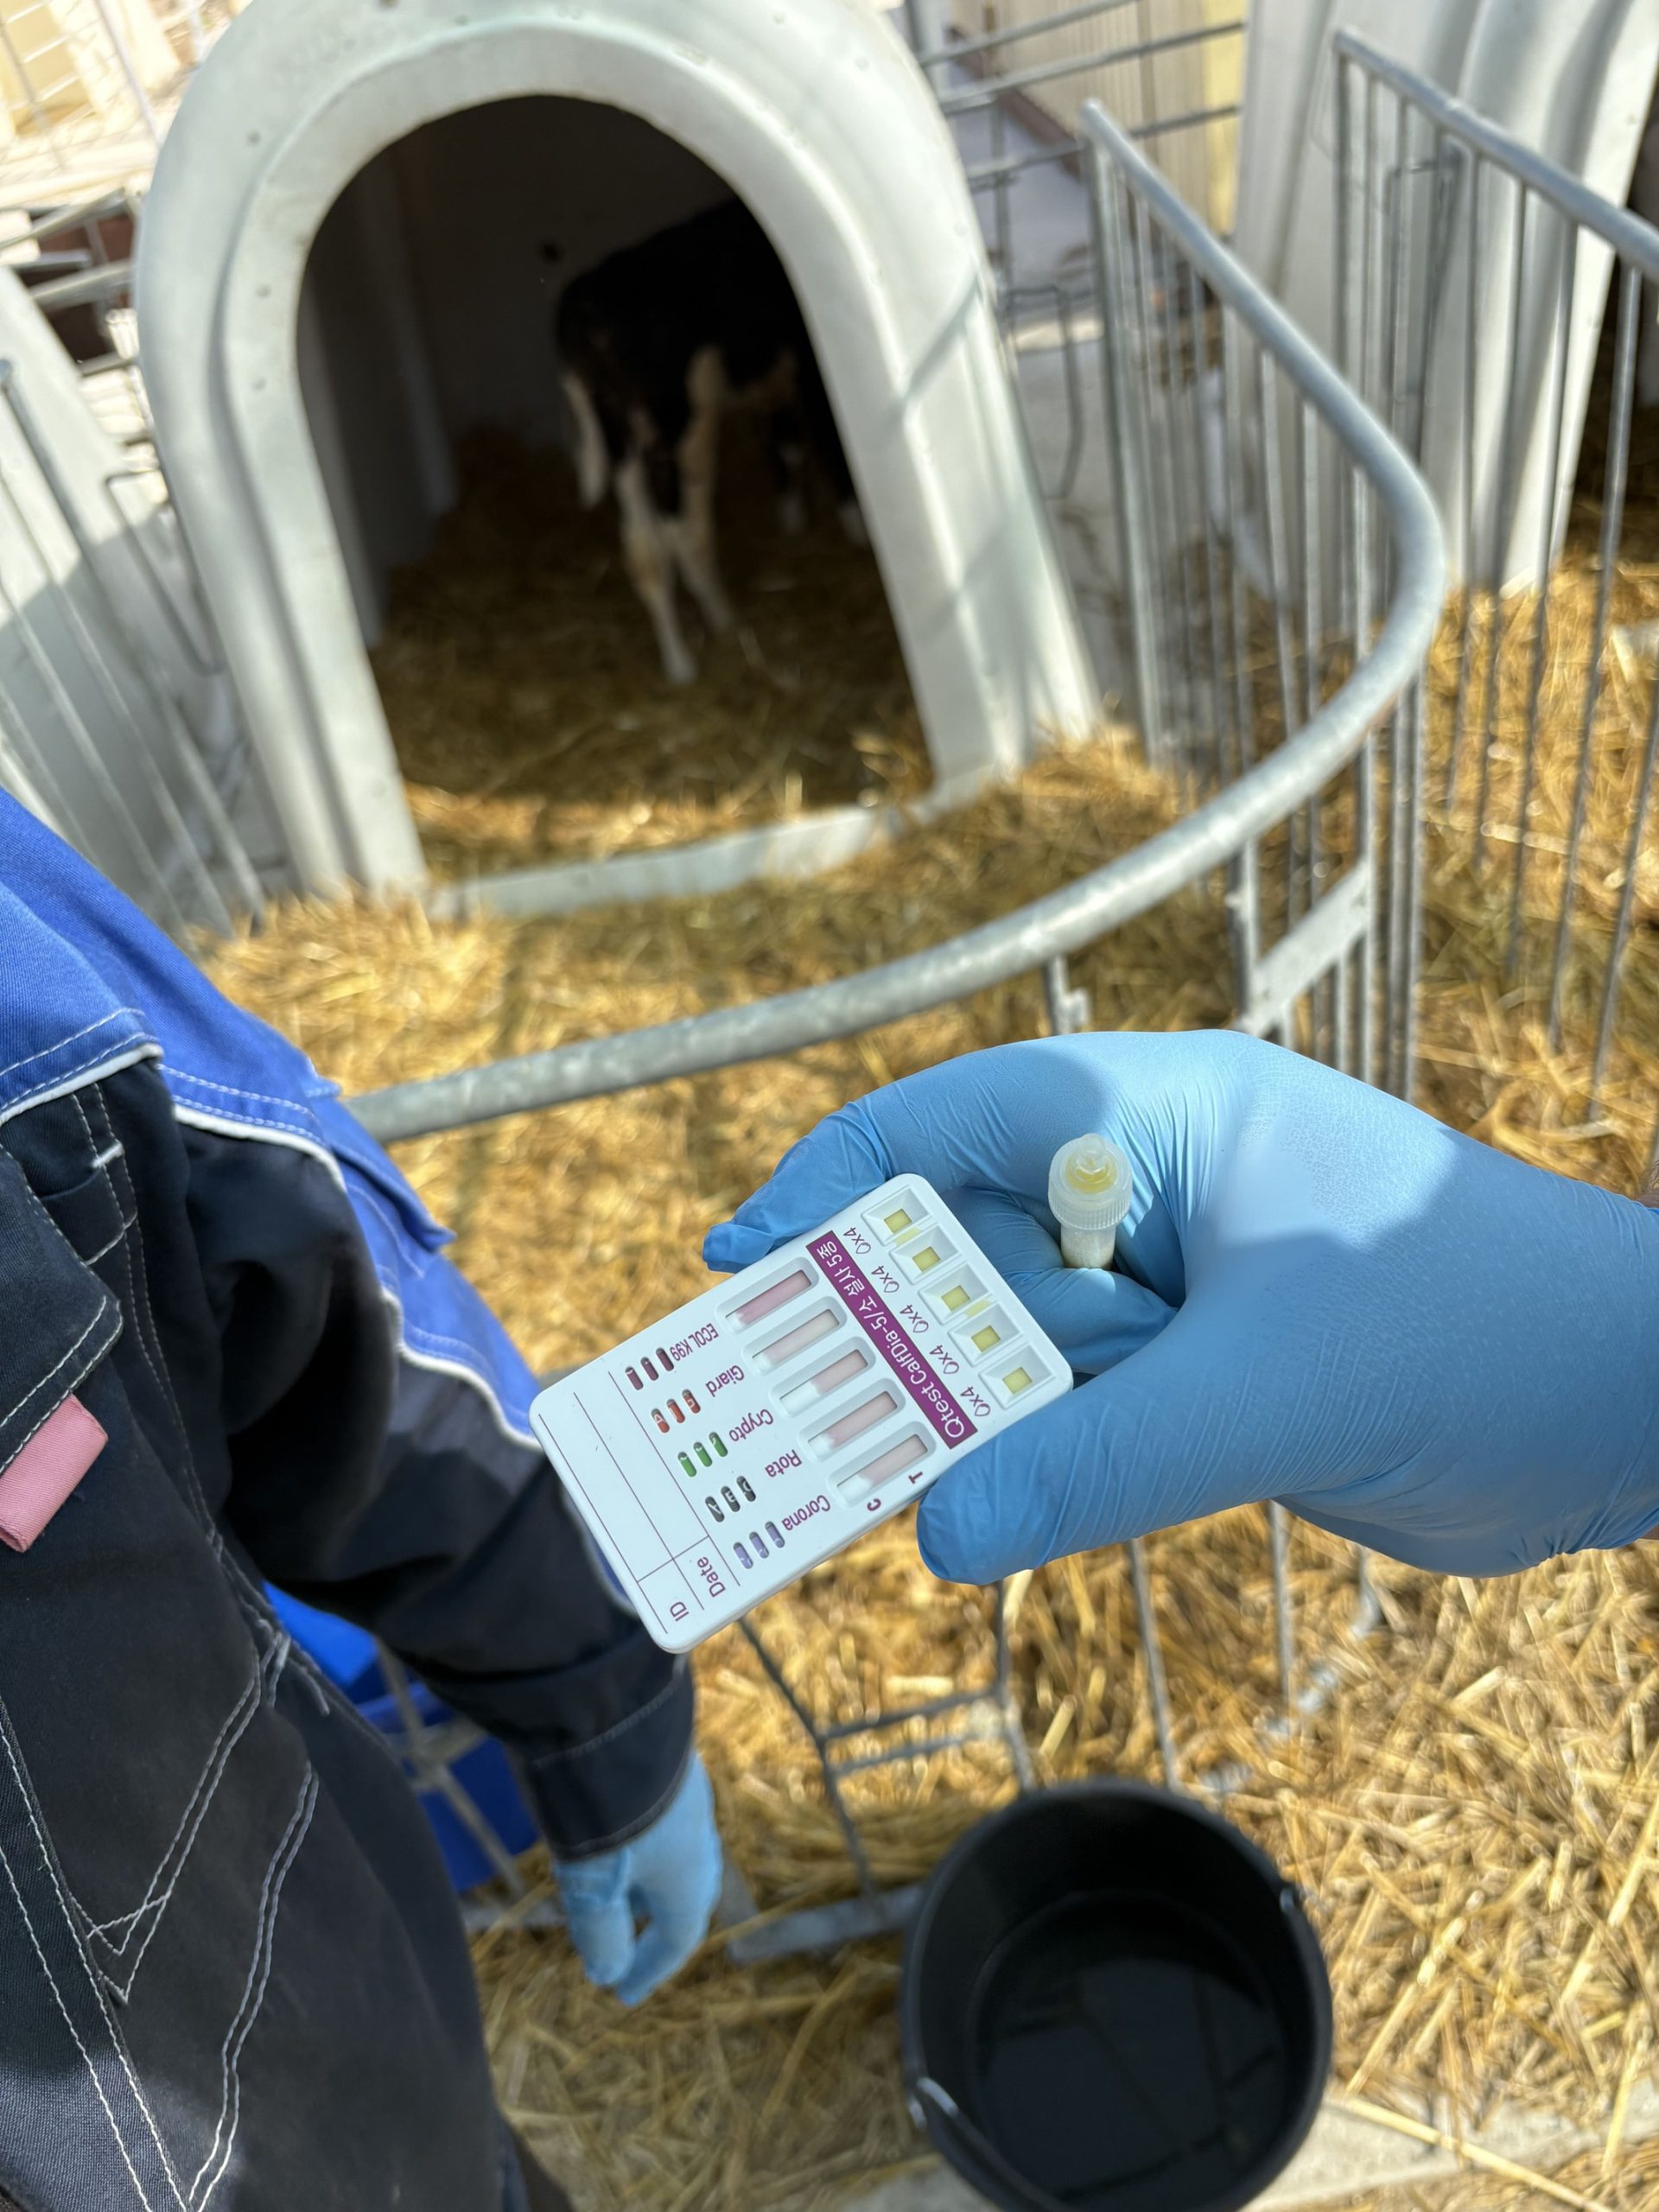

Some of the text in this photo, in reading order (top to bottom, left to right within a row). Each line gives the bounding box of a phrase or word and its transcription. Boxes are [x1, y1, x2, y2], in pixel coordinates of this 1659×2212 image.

[843, 1227, 864, 1245] x4
[817, 1241, 842, 1267] 5종
[835, 1266, 865, 1295] 설사
[871, 1265, 893, 1284] x4
[899, 1304, 923, 1323] x4
[670, 1323, 719, 1361] ECOL K99
[930, 1344, 953, 1364] x4
[705, 1365, 745, 1397] Giard
[961, 1386, 984, 1407] x4
[921, 1382, 964, 1438] Qtest
[729, 1409, 773, 1441] Crypto
[765, 1449, 802, 1478] Rota
[908, 1471, 924, 1484] T
[782, 1495, 830, 1530] Corona
[867, 1497, 880, 1512] C
[697, 1556, 726, 1597] Date
[670, 1601, 689, 1622] ID
